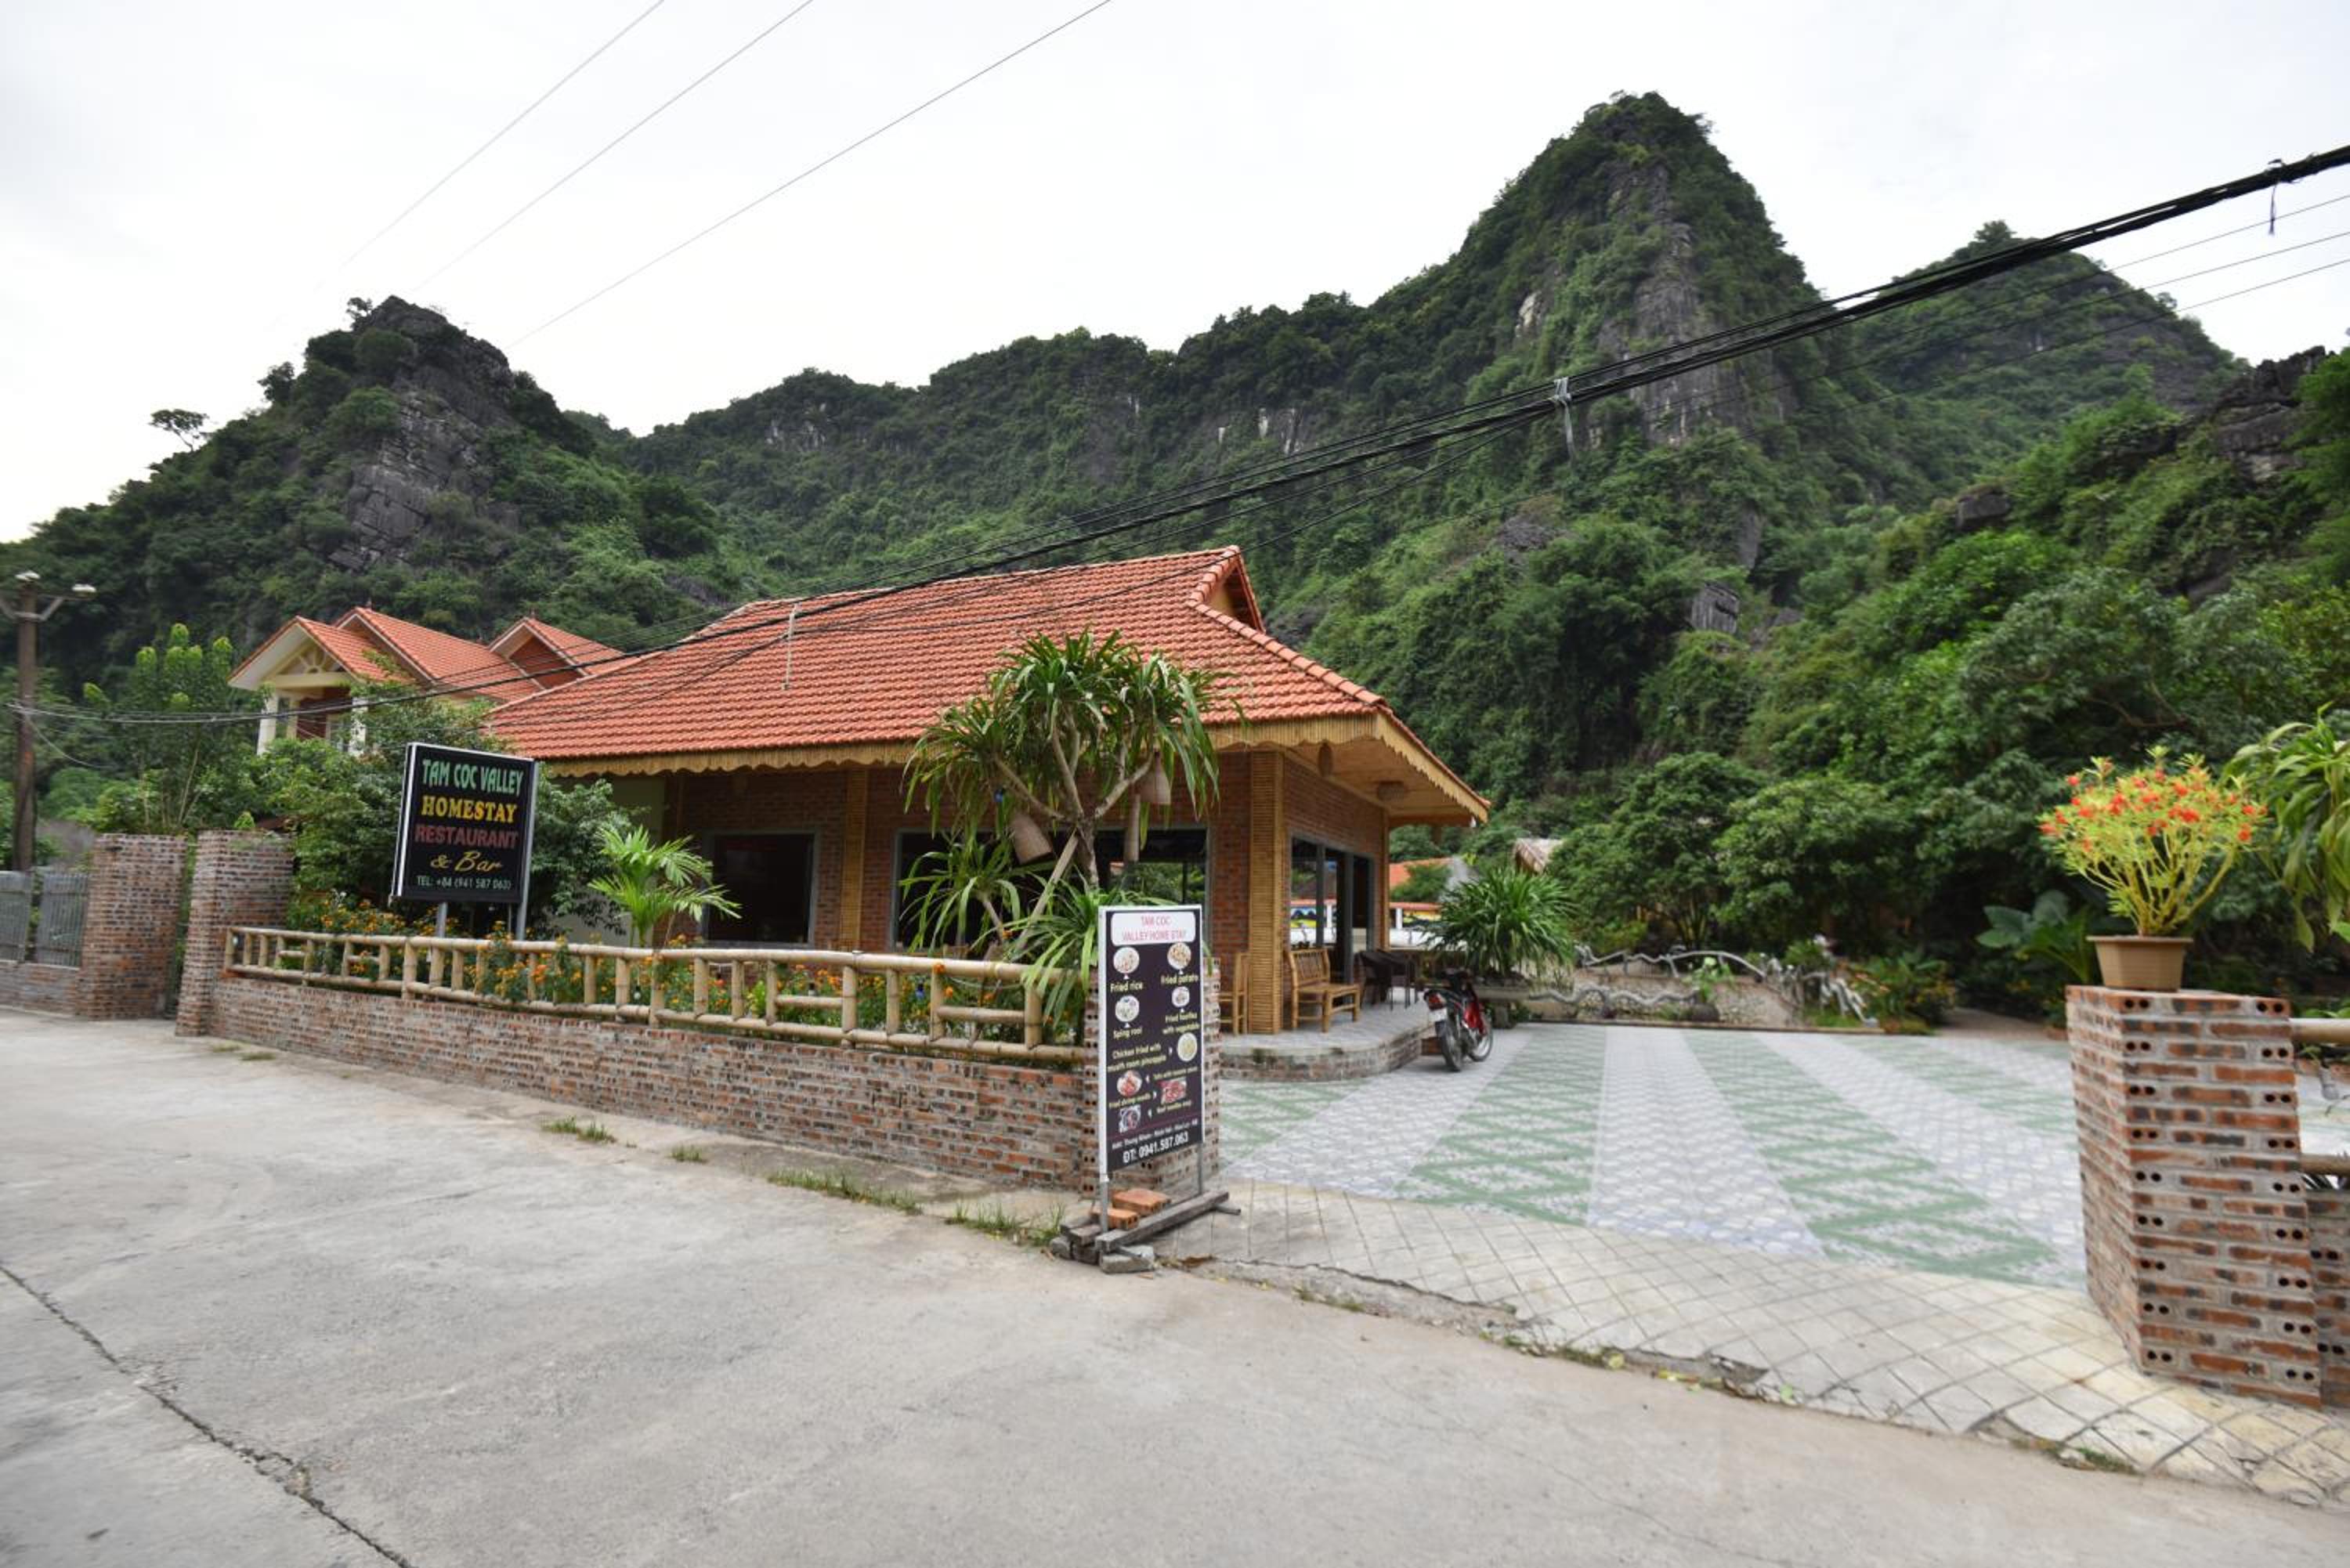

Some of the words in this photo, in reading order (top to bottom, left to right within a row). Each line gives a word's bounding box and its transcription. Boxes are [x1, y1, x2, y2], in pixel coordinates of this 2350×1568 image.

[422, 759, 450, 788] TAM
[454, 763, 478, 789] COC
[480, 766, 524, 797] VALLEY
[421, 795, 518, 822] HOMESTAY
[414, 823, 519, 849] RESTAURANT
[430, 854, 450, 869] &
[454, 850, 503, 873] Bar
[1122, 930, 1148, 942] VALLEY
[1110, 981, 1129, 993] Fried
[1130, 981, 1144, 991] rice
